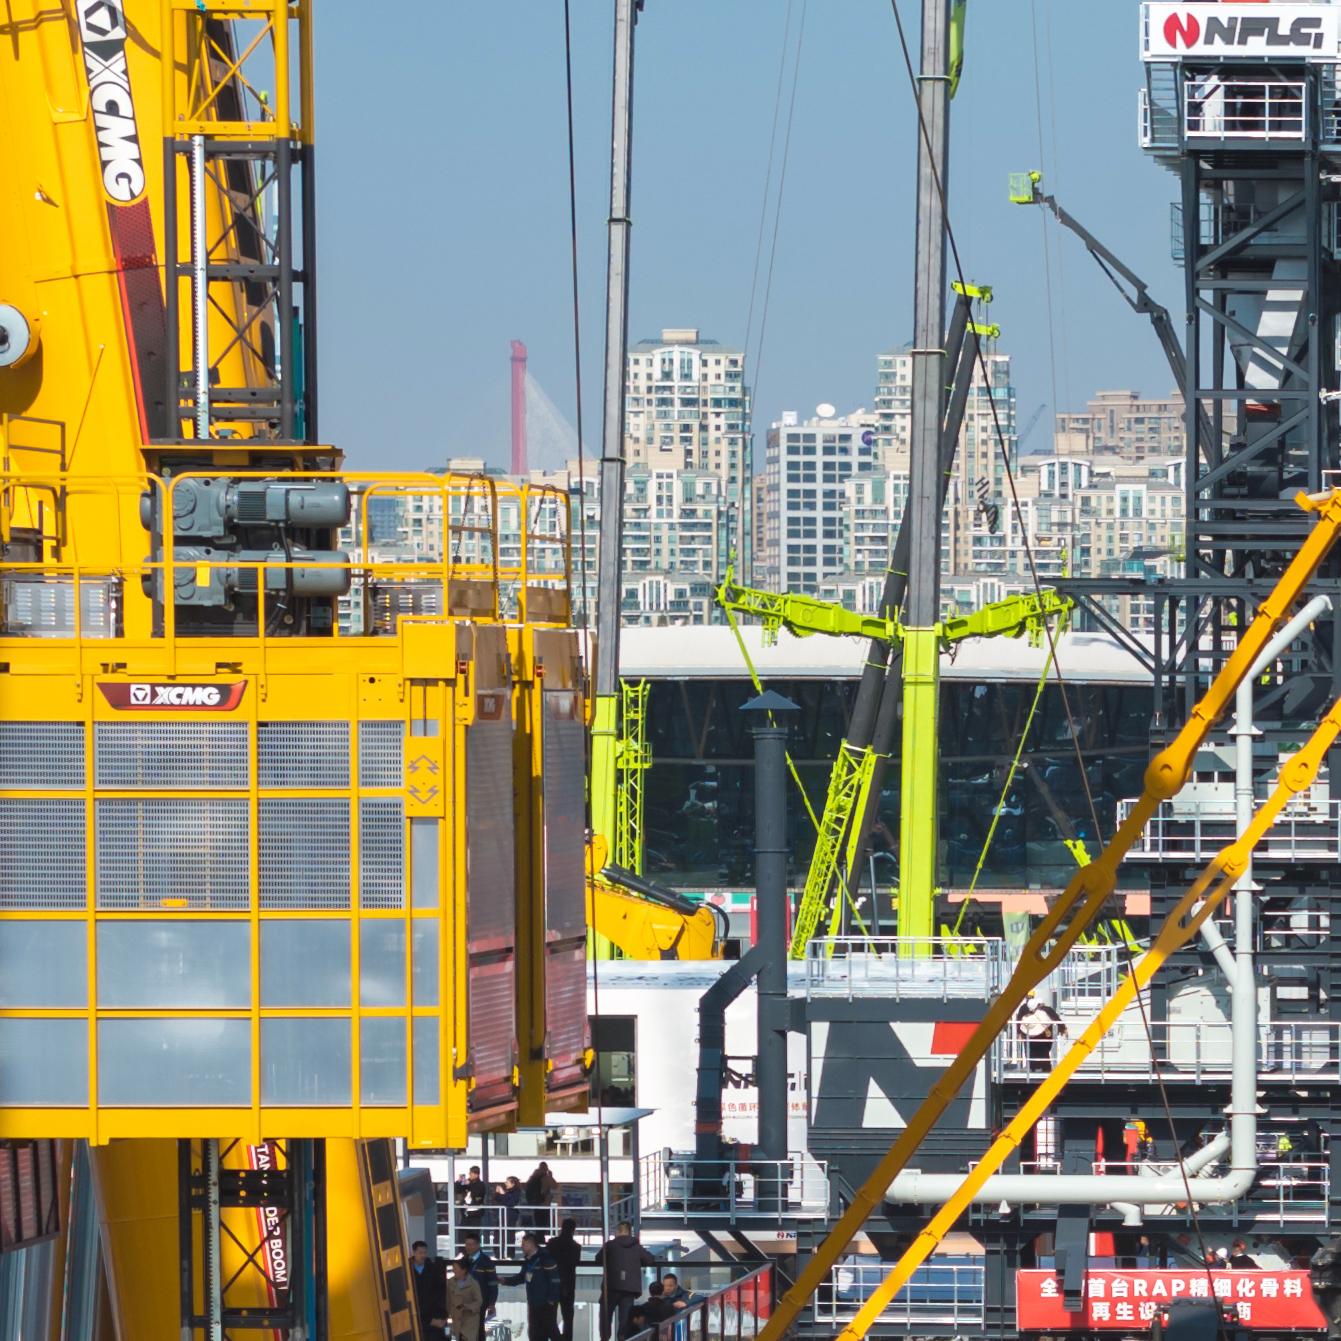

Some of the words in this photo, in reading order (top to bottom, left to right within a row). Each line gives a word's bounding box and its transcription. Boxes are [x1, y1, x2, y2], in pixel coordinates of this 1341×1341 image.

[86, 48, 146, 202] XCMG
[153, 687, 221, 707] XCMG
[1040, 1276, 1304, 1299] 全首台RAP精细化骨料
